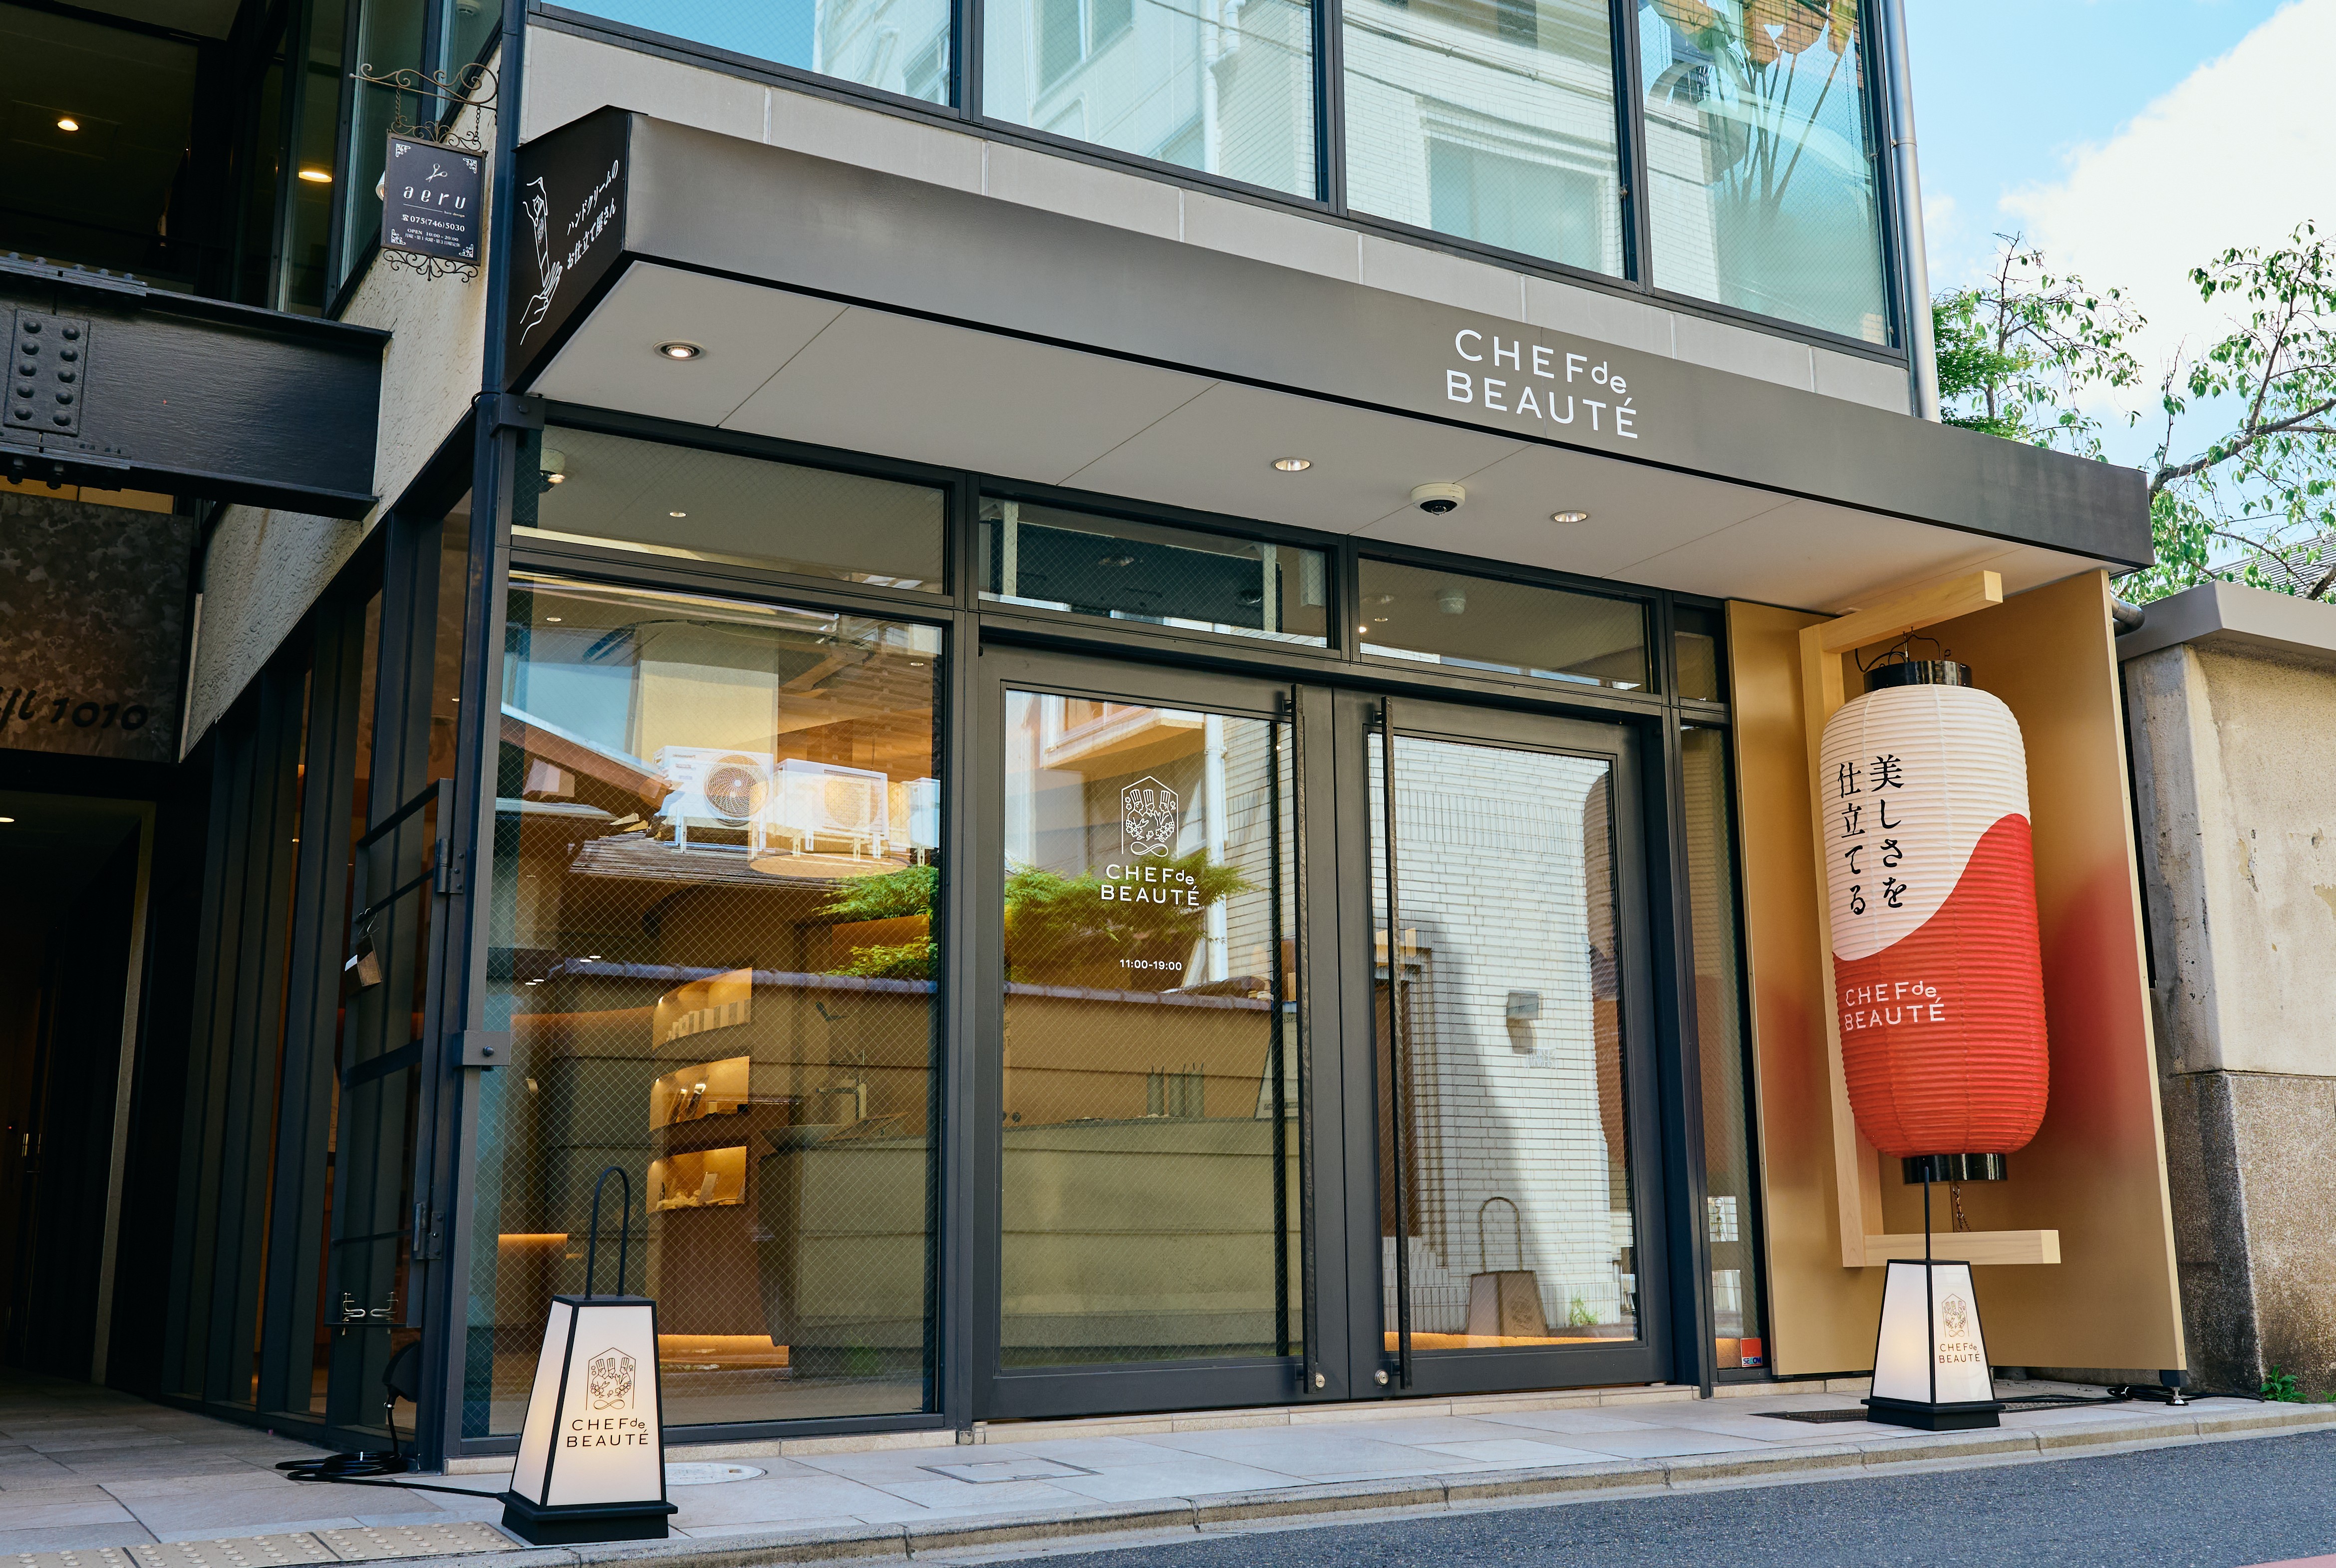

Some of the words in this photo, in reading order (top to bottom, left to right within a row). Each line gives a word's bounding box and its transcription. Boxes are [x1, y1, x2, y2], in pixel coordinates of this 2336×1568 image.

[403, 186, 466, 209] aeru
[567, 160, 618, 236] ハンドクリームの
[410, 216, 465, 232] 075(746)5030
[567, 198, 616, 269] お仕立て屋さん
[1447, 369, 1638, 439] BEAUTÉ
[51, 697, 148, 730] 1010
[1837, 762, 1866, 915] 仕立てる
[1869, 754, 1907, 908] 美しさを
[1101, 884, 1199, 906] BEAUTÉ
[1119, 959, 1182, 971] 11:00-19:00
[1844, 997, 1946, 1032] BEAUTÉ
[1939, 1350, 1981, 1363] BEAUTÉ
[567, 1430, 648, 1448] BEAUTÉ
